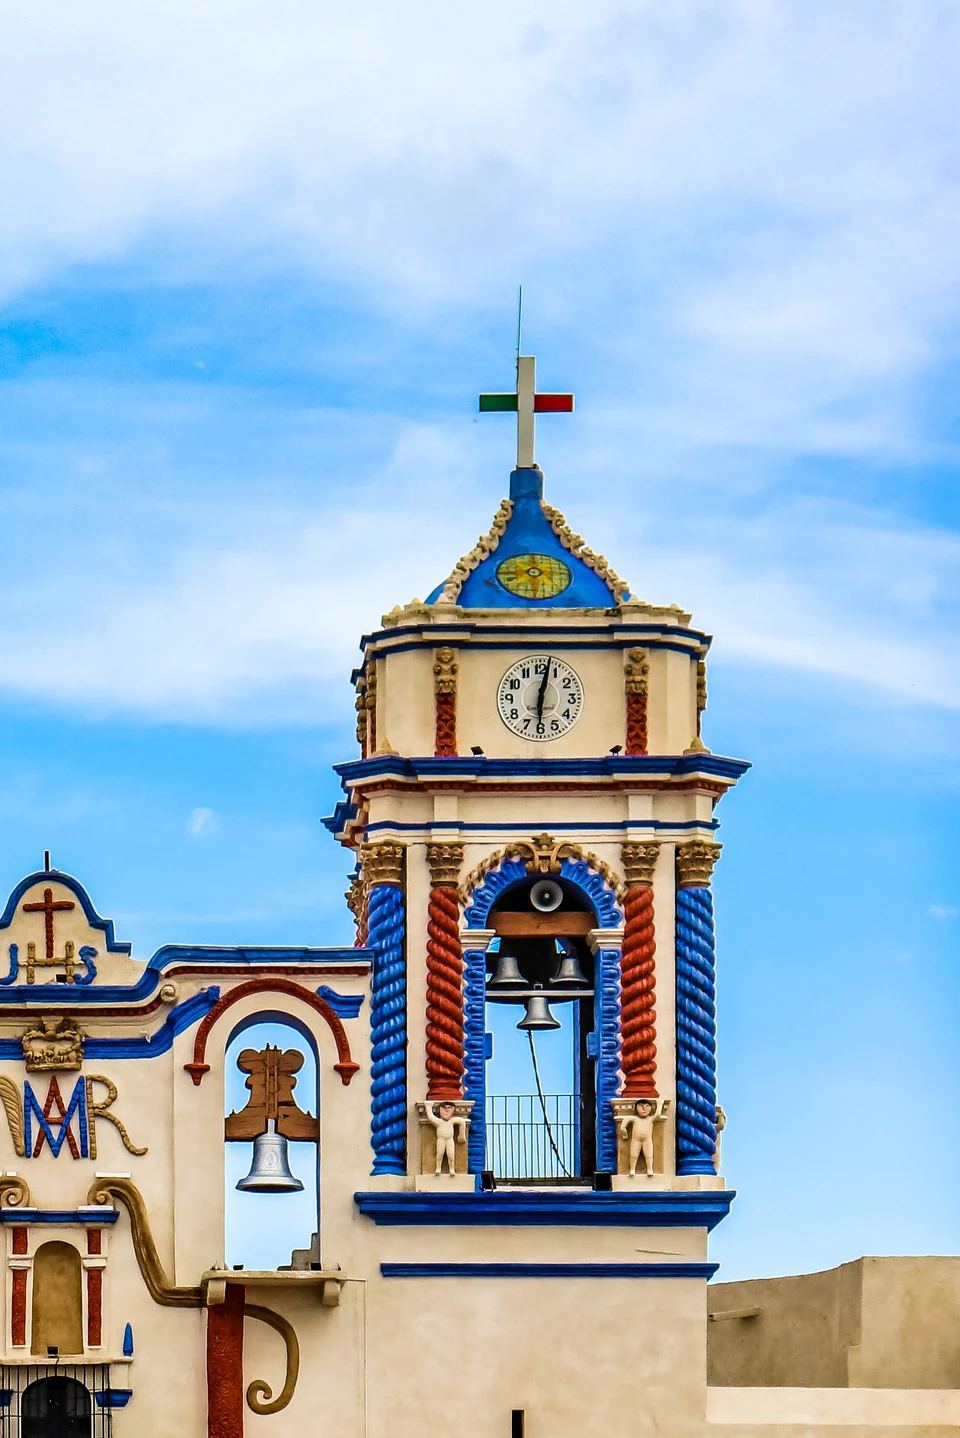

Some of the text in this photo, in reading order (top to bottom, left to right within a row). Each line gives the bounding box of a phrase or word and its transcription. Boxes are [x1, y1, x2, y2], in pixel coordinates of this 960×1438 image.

[522, 667, 530, 678] 11
[535, 664, 547, 675] 12
[553, 667, 558, 678] 1
[509, 678, 520, 690] 10
[562, 677, 571, 689] 2
[505, 693, 514, 704] 9
[567, 693, 576, 704] 3
[510, 708, 518, 719] 8
[562, 708, 570, 719] 4
[523, 719, 531, 730] 7
[536, 722, 545, 734] 6
[551, 719, 559, 731] 5
